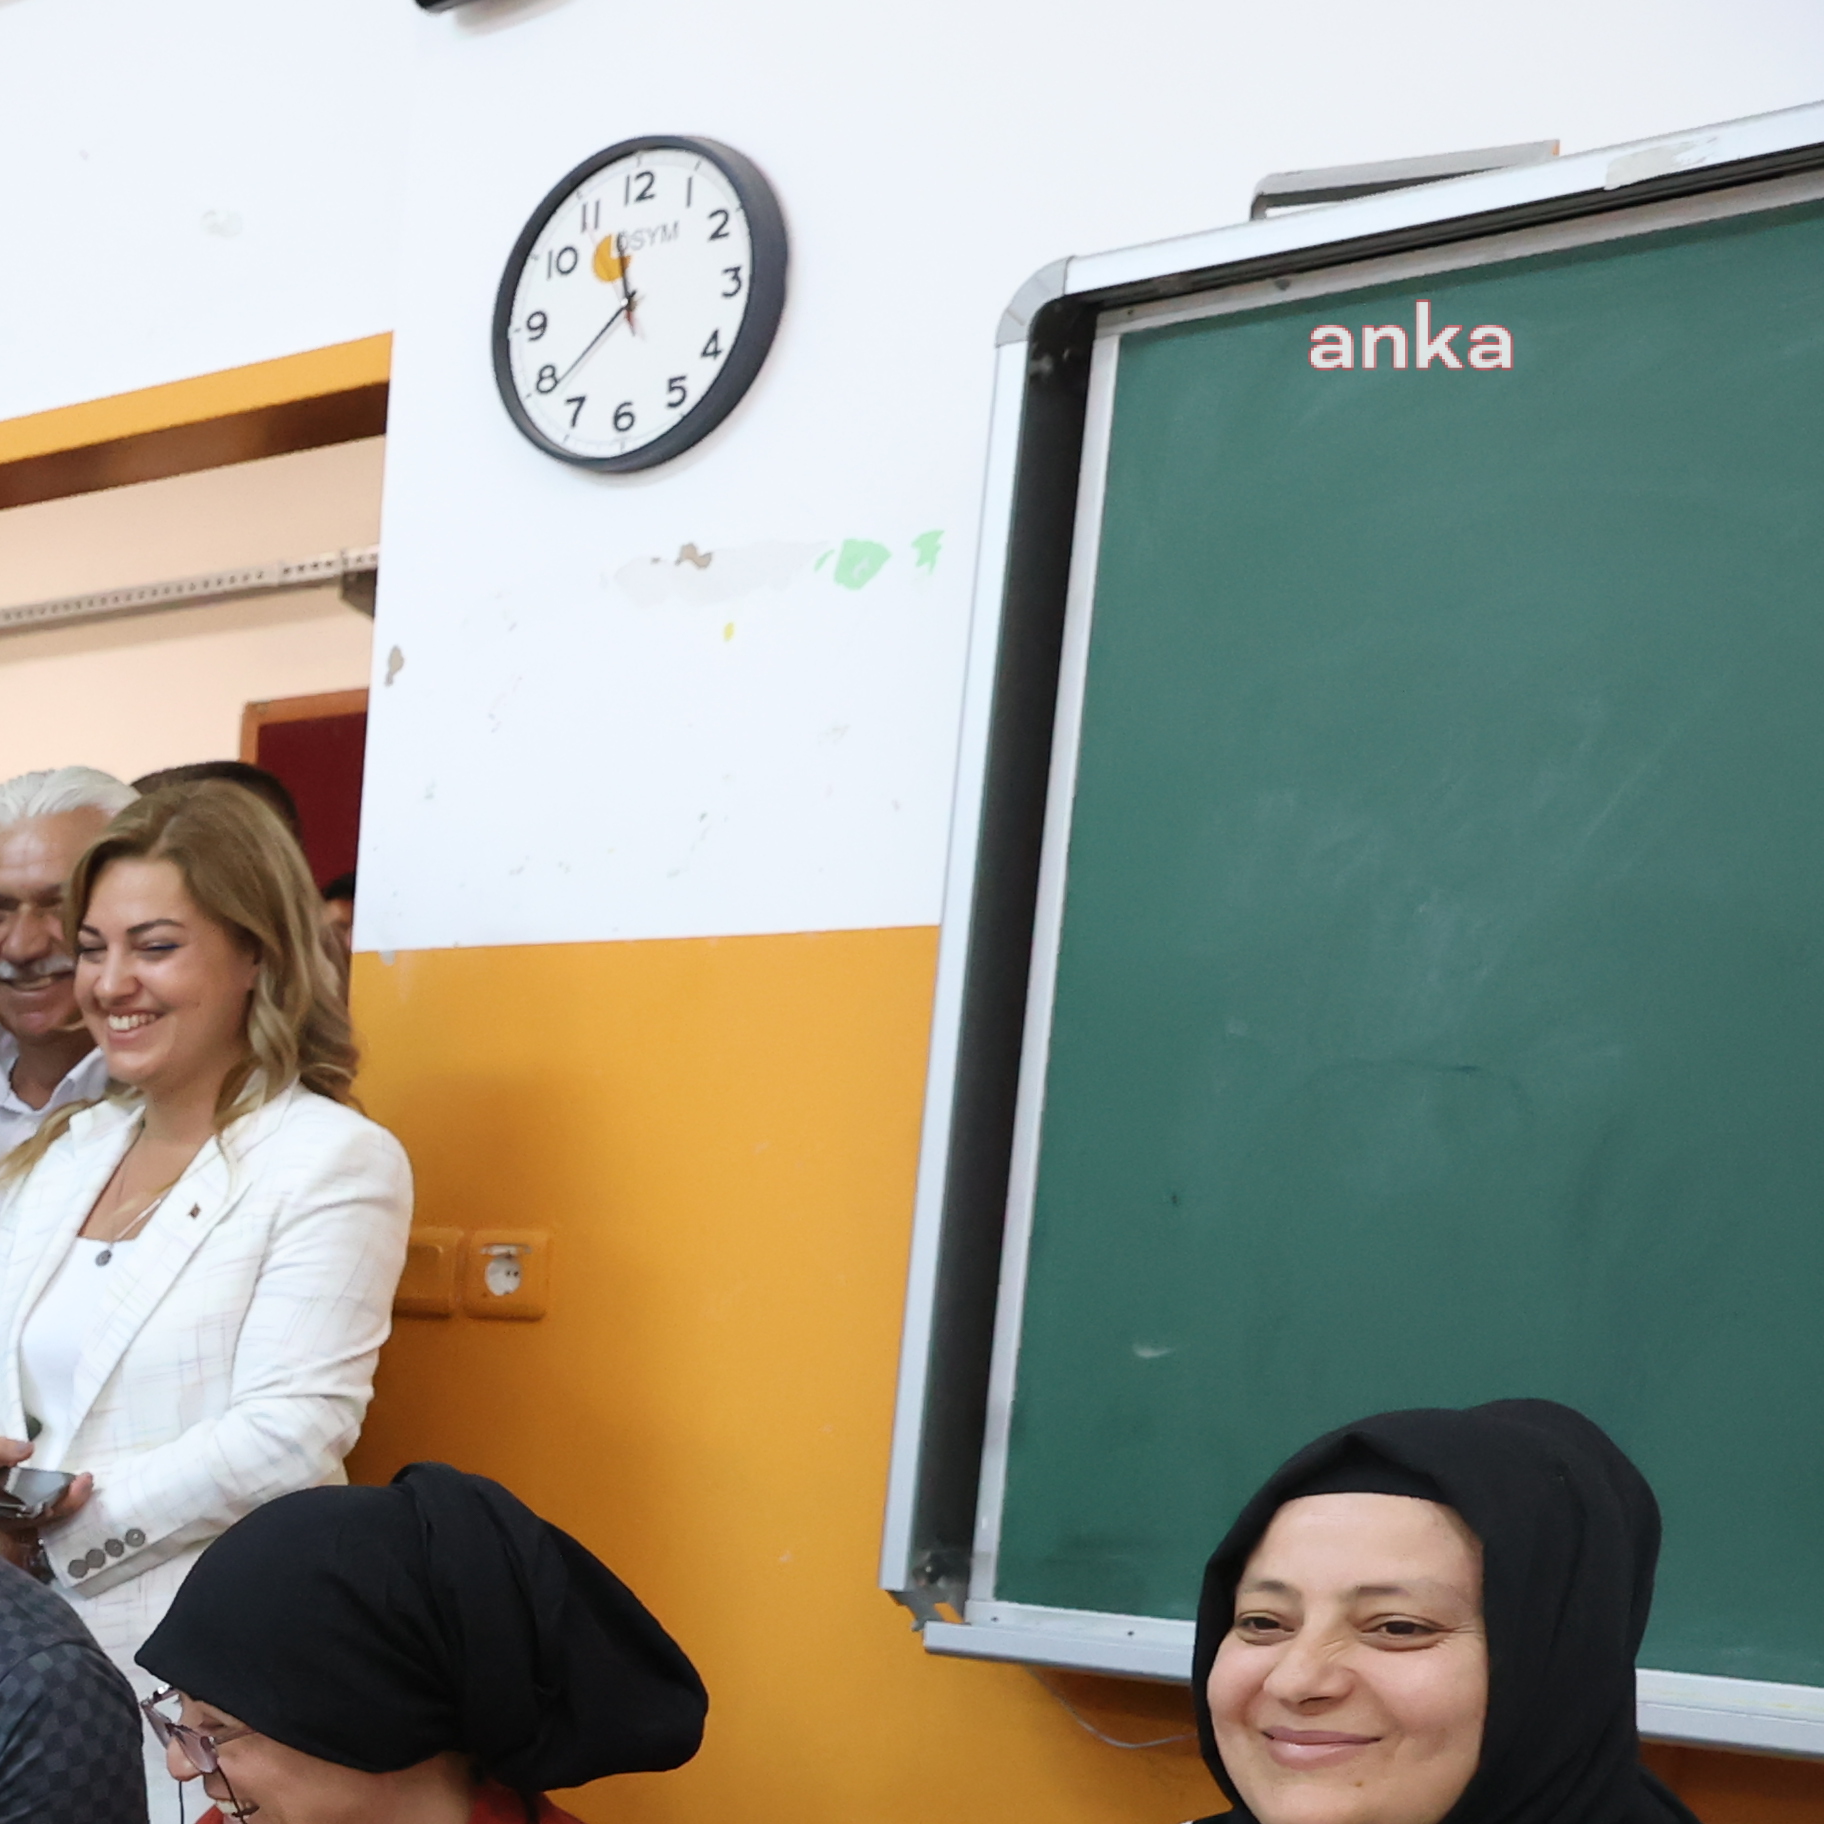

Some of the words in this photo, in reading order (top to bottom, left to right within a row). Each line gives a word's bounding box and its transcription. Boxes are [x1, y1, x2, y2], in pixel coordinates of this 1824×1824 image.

[625, 171, 656, 205] 12
[685, 175, 694, 209] 1
[578, 198, 601, 234] 11
[708, 208, 730, 242] 2
[547, 245, 579, 280] 10
[722, 265, 743, 299] 3
[525, 310, 549, 342] 9
[700, 329, 723, 360] 4
[535, 364, 559, 395] 8
[666, 375, 688, 409] 5
[565, 395, 587, 429] 7
[612, 401, 636, 433] 6
